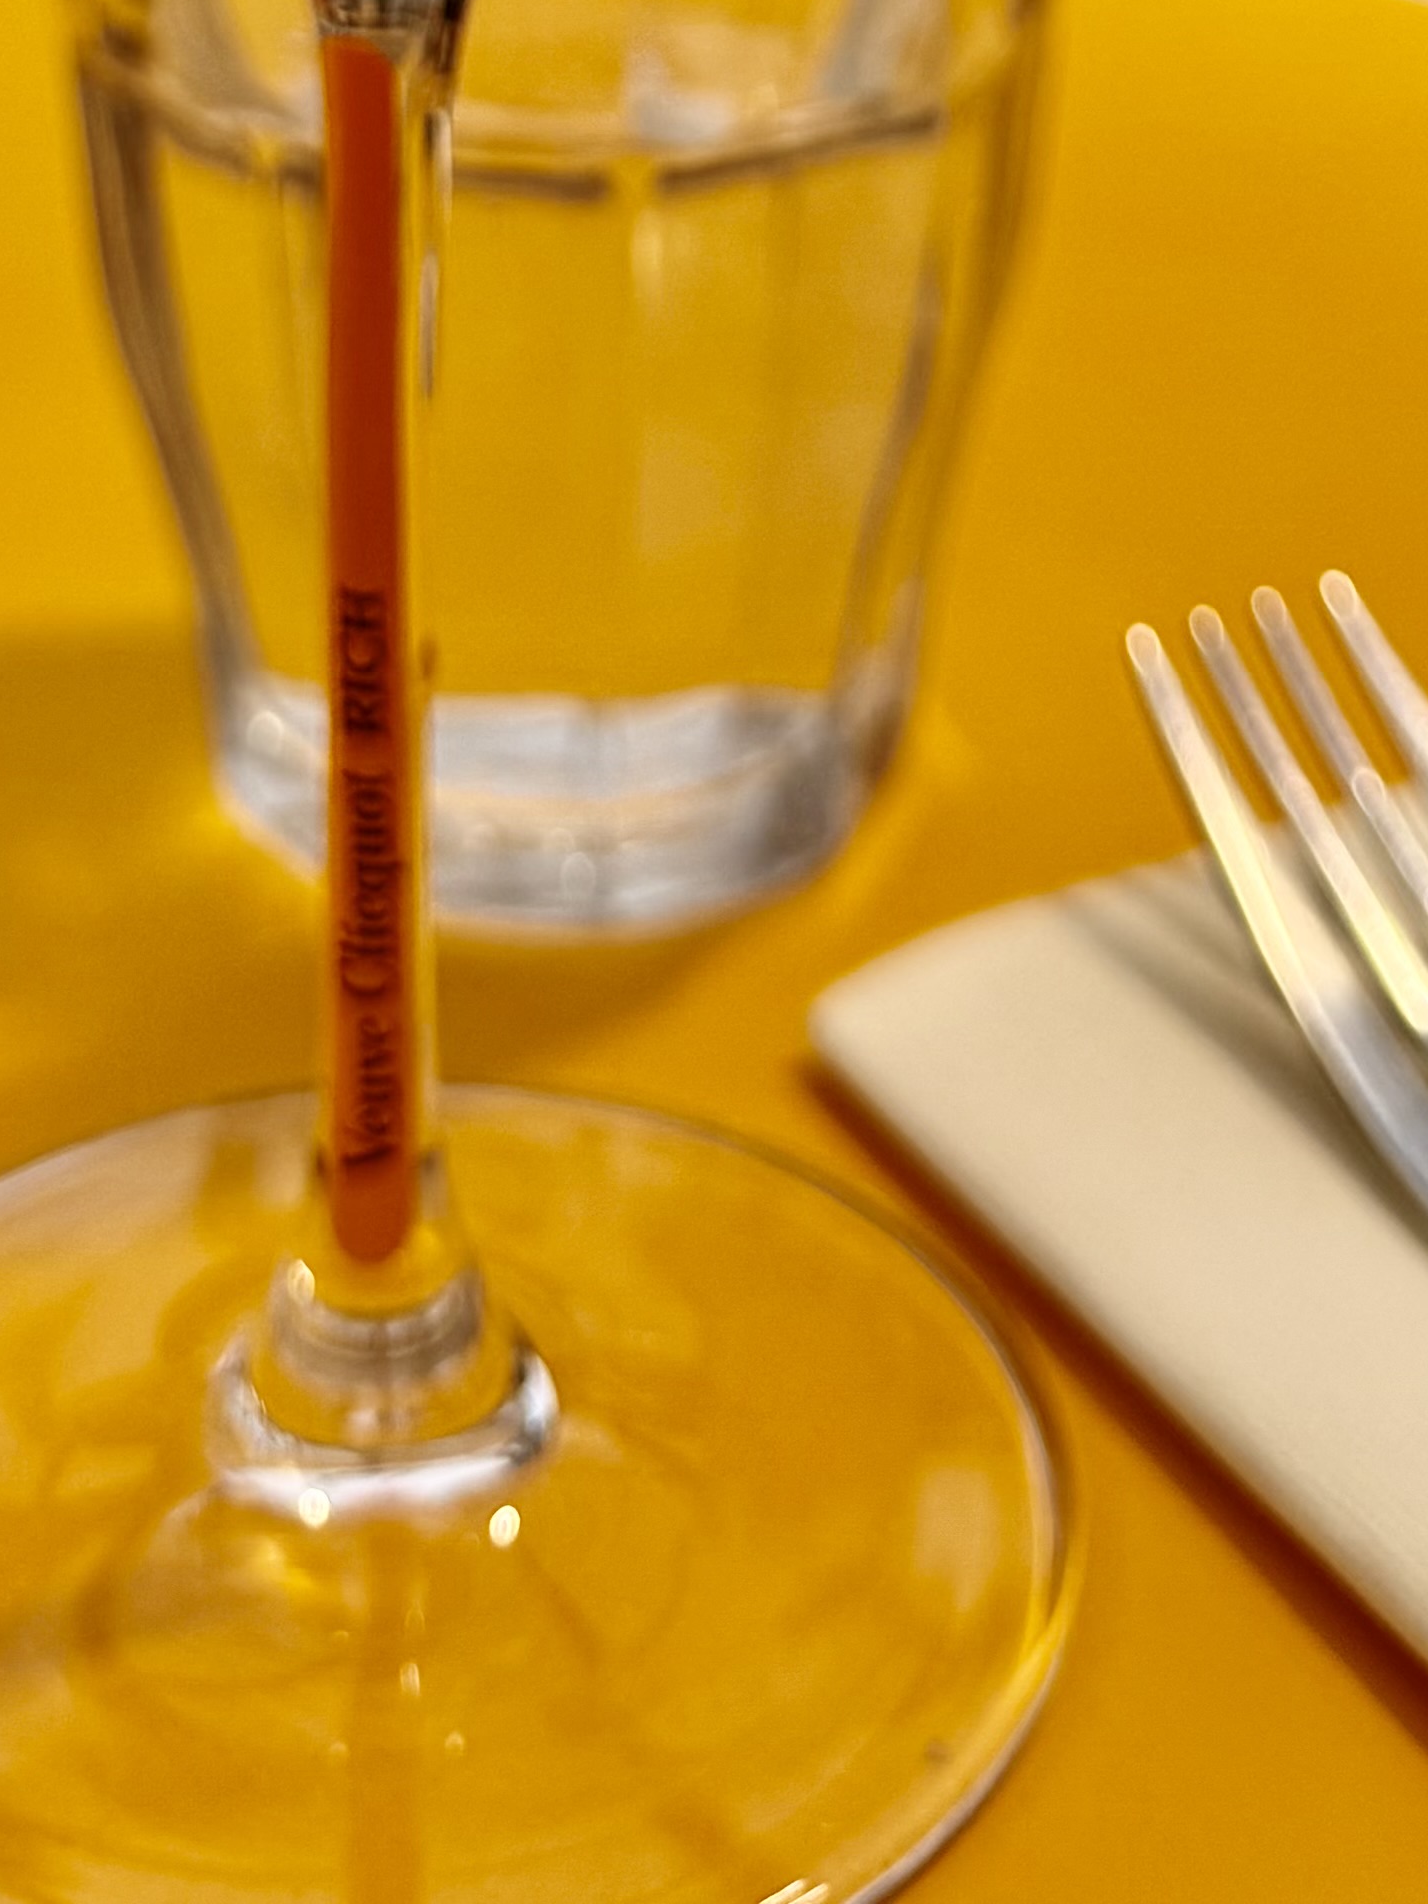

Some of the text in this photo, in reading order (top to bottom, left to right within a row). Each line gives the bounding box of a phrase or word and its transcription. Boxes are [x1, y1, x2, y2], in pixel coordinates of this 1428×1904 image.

[339, 586, 404, 1167] Veuve Clicquot RICH
